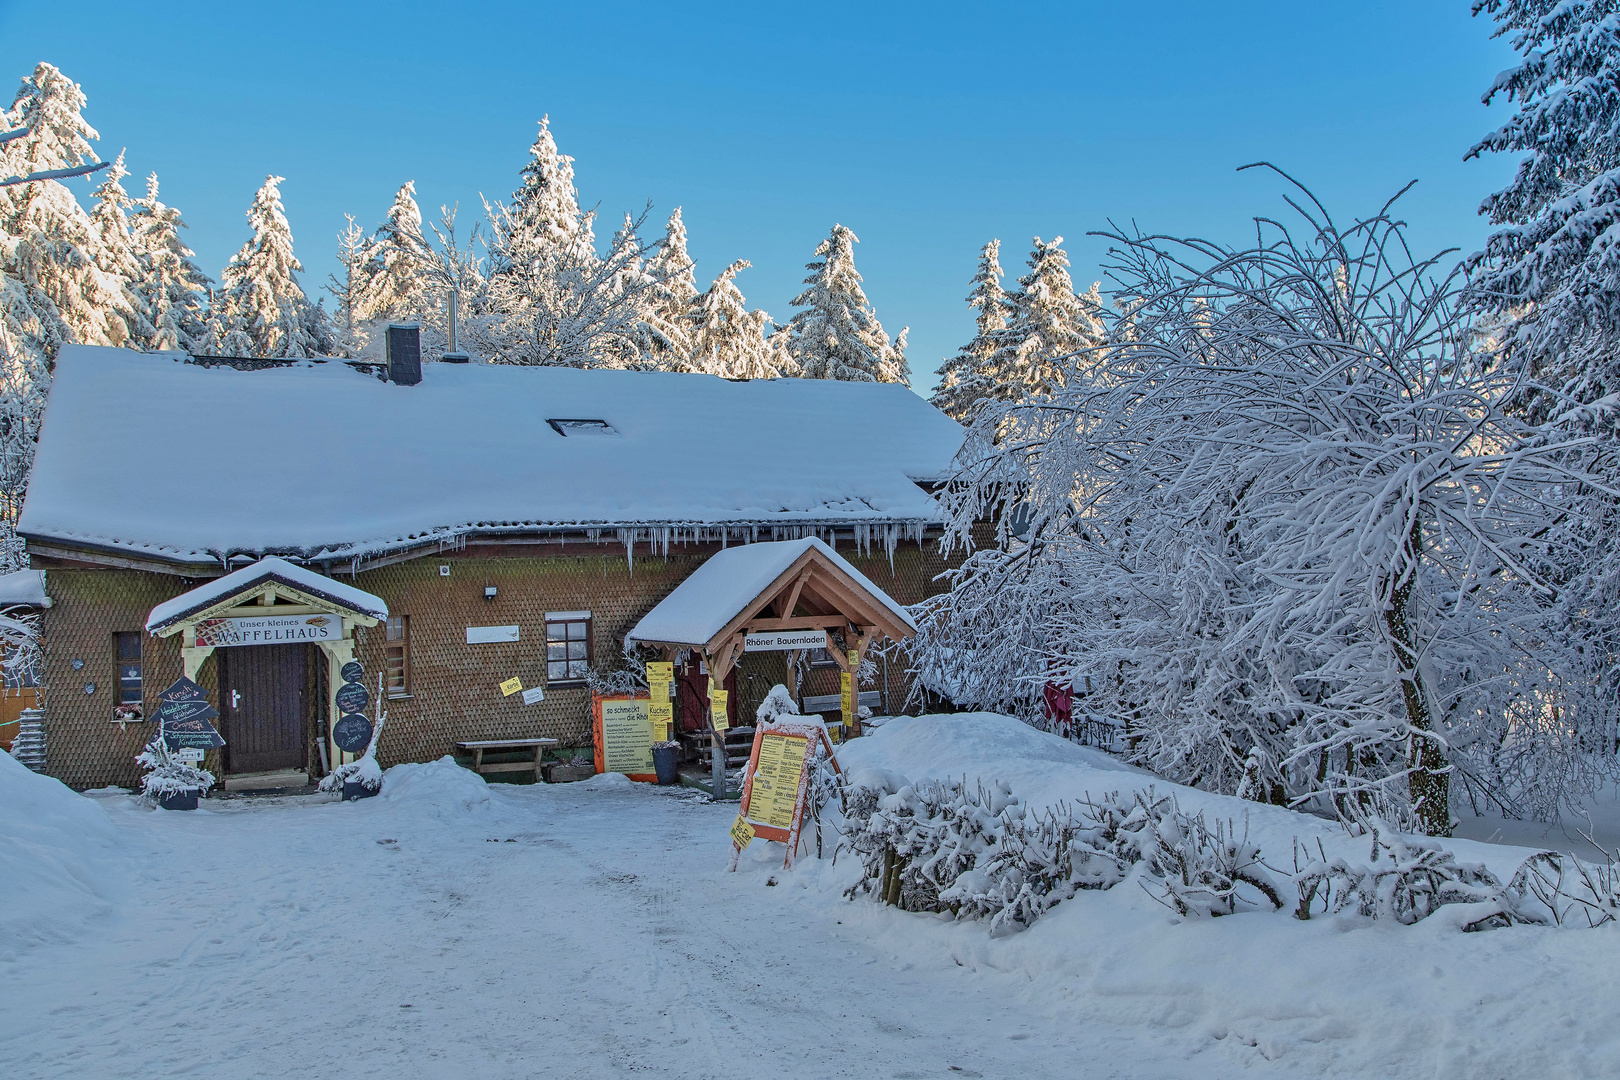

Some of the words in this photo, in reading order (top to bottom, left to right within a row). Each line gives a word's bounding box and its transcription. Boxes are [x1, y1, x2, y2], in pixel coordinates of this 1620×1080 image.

[240, 621, 265, 629] Unser
[267, 619, 299, 628] kleines
[217, 627, 328, 643] WAFFELHAUS
[746, 638, 774, 647] Rhöner
[777, 636, 825, 645] Bauernladen
[614, 705, 640, 714] schmeckt
[649, 706, 670, 715] Kuchen
[627, 713, 636, 721] die
